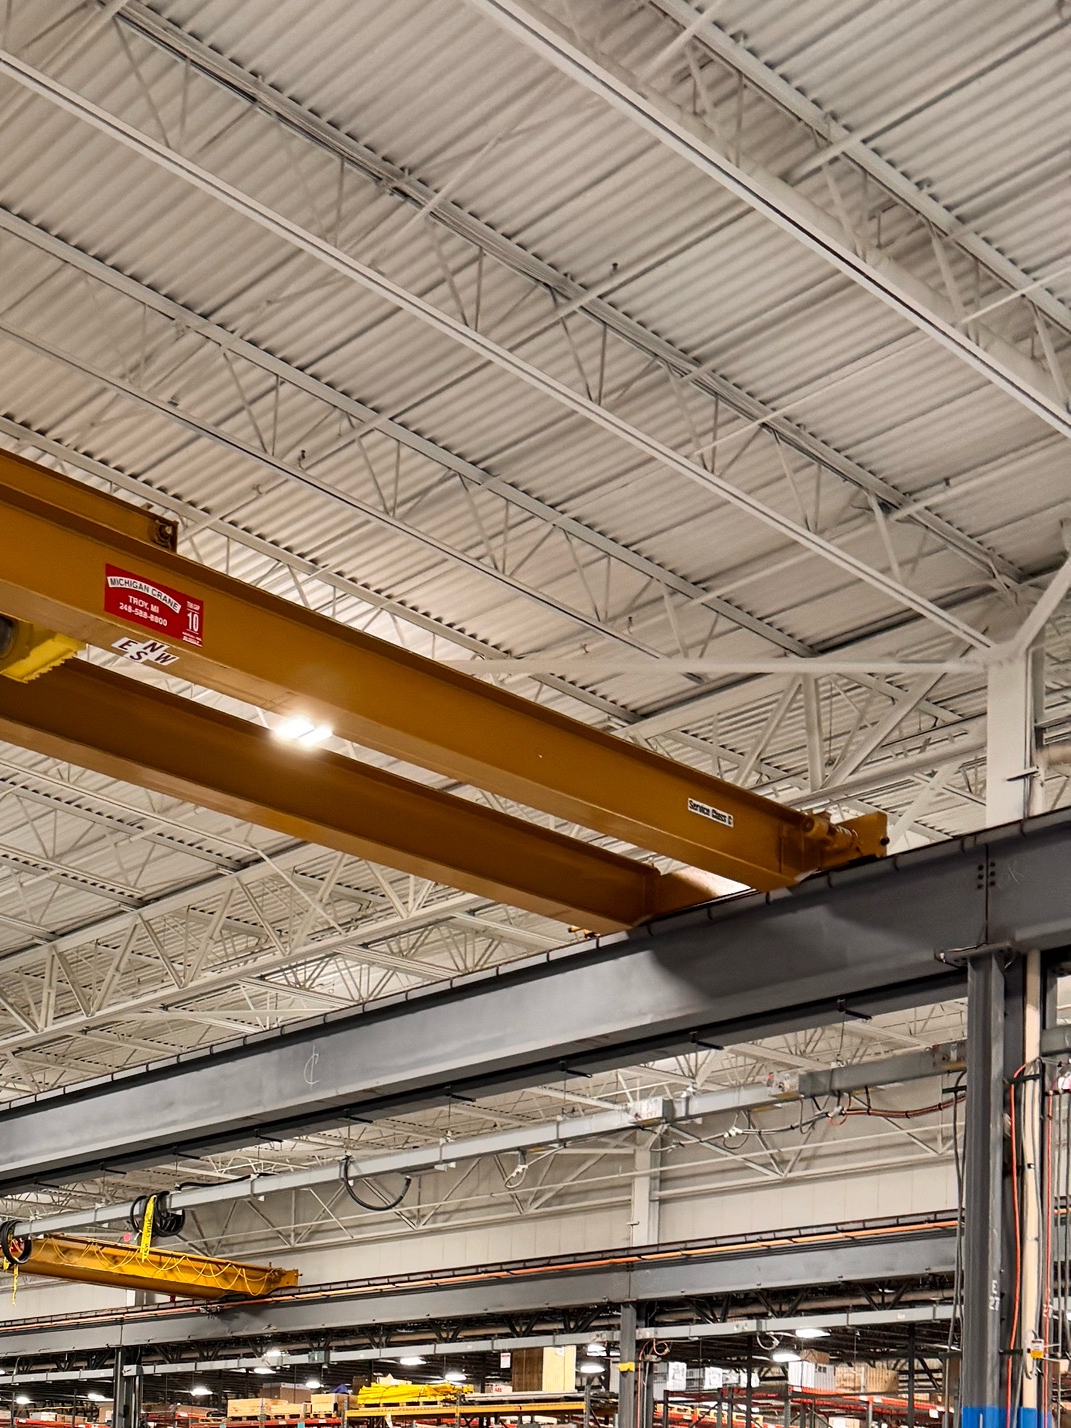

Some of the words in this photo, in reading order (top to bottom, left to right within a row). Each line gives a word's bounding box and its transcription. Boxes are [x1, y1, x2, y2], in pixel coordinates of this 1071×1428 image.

[109, 577, 150, 594] MICHIGAN
[151, 588, 179, 611] CRANE
[128, 595, 149, 611] TROY,
[150, 604, 160, 614] MI
[187, 612, 199, 632] 10
[118, 640, 138, 651] E
[143, 641, 164, 653] N
[129, 651, 148, 661] S
[154, 652, 176, 664] W
